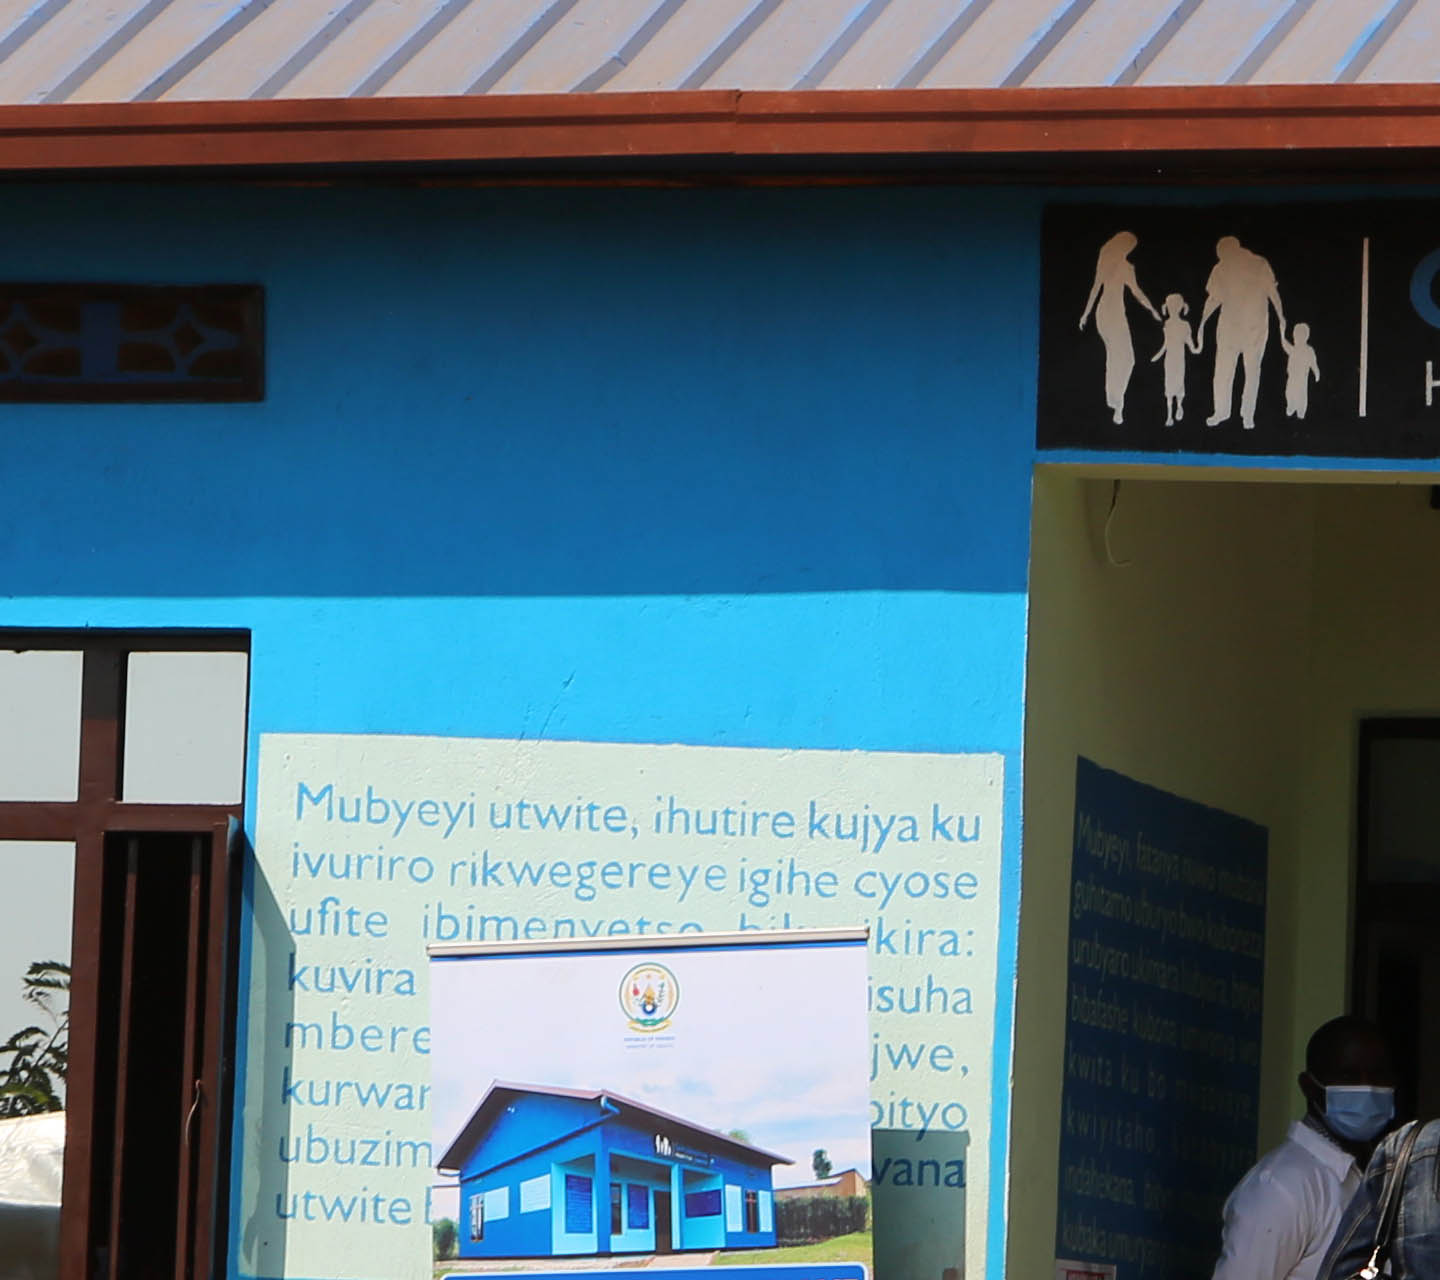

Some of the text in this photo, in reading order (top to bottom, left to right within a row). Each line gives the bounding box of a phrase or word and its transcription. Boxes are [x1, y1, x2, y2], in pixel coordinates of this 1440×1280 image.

[297, 782, 980, 853] Mubyeyi utwite, ihutire kujya ku
[293, 842, 978, 910] ivuriro rikwegereye igihe cyose
[284, 897, 387, 942] ufite
[288, 959, 415, 995] kuvira
[276, 1187, 410, 1224] utwite
